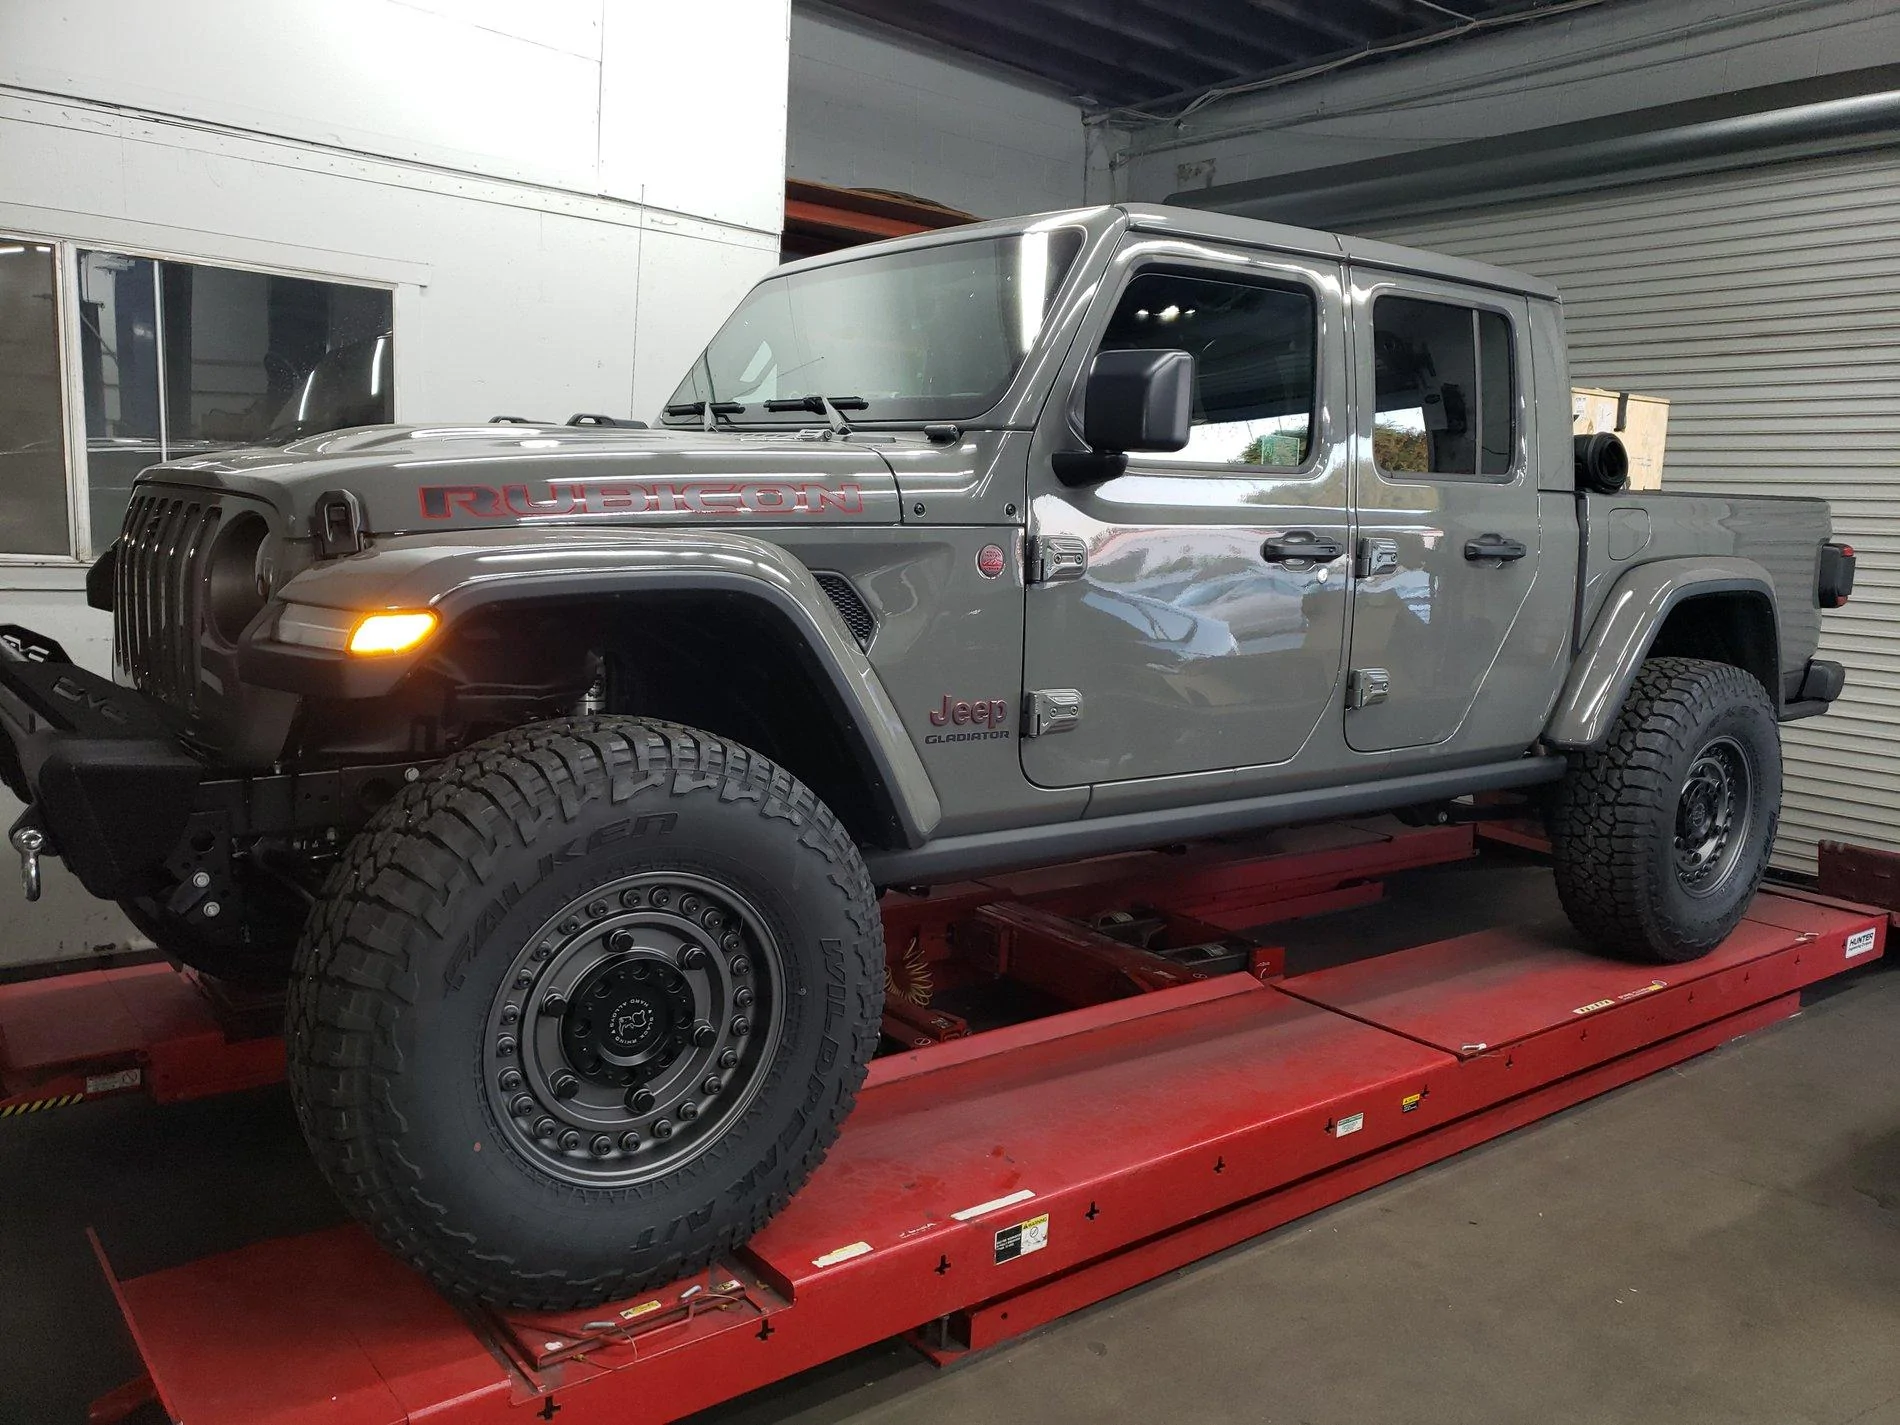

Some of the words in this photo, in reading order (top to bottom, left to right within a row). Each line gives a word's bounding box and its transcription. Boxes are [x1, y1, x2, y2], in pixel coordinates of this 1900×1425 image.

[417, 483, 865, 519] RUBICON
[929, 693, 1008, 729] Jeep
[924, 730, 1010, 745] GLADIATOR
[443, 810, 680, 992] FALKEN
[1849, 932, 1874, 947] HUNTER
[609, 1001, 627, 1028] ALLOYS
[630, 998, 649, 1007] HARD
[614, 1036, 637, 1044] RHINO
[640, 1017, 654, 1039] BLACK
[724, 937, 848, 1201] WILDPEAK
